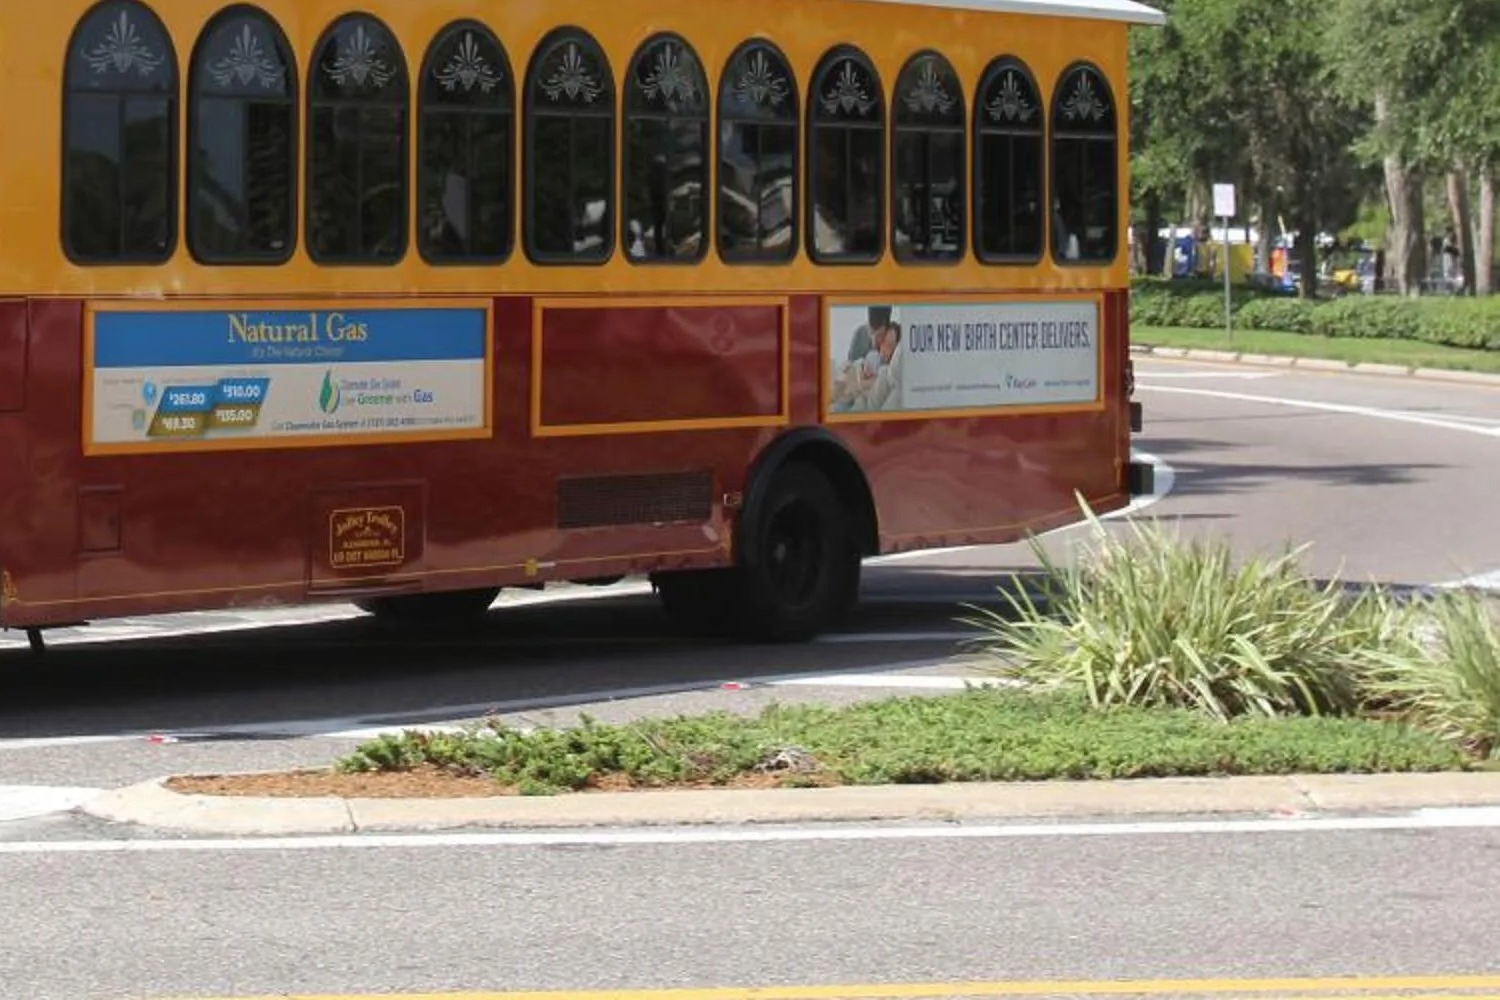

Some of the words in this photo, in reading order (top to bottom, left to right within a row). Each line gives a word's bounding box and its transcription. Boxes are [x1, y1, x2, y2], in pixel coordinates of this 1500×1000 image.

[227, 312, 319, 343] Natural
[326, 311, 368, 341] Gas
[910, 323, 935, 353] OUR
[937, 323, 961, 352] NEW
[965, 322, 997, 351] BIRTH
[999, 321, 1039, 349] CENTER
[1041, 320, 1091, 348] DELIVERS.
[413, 389, 433, 403] Gas
